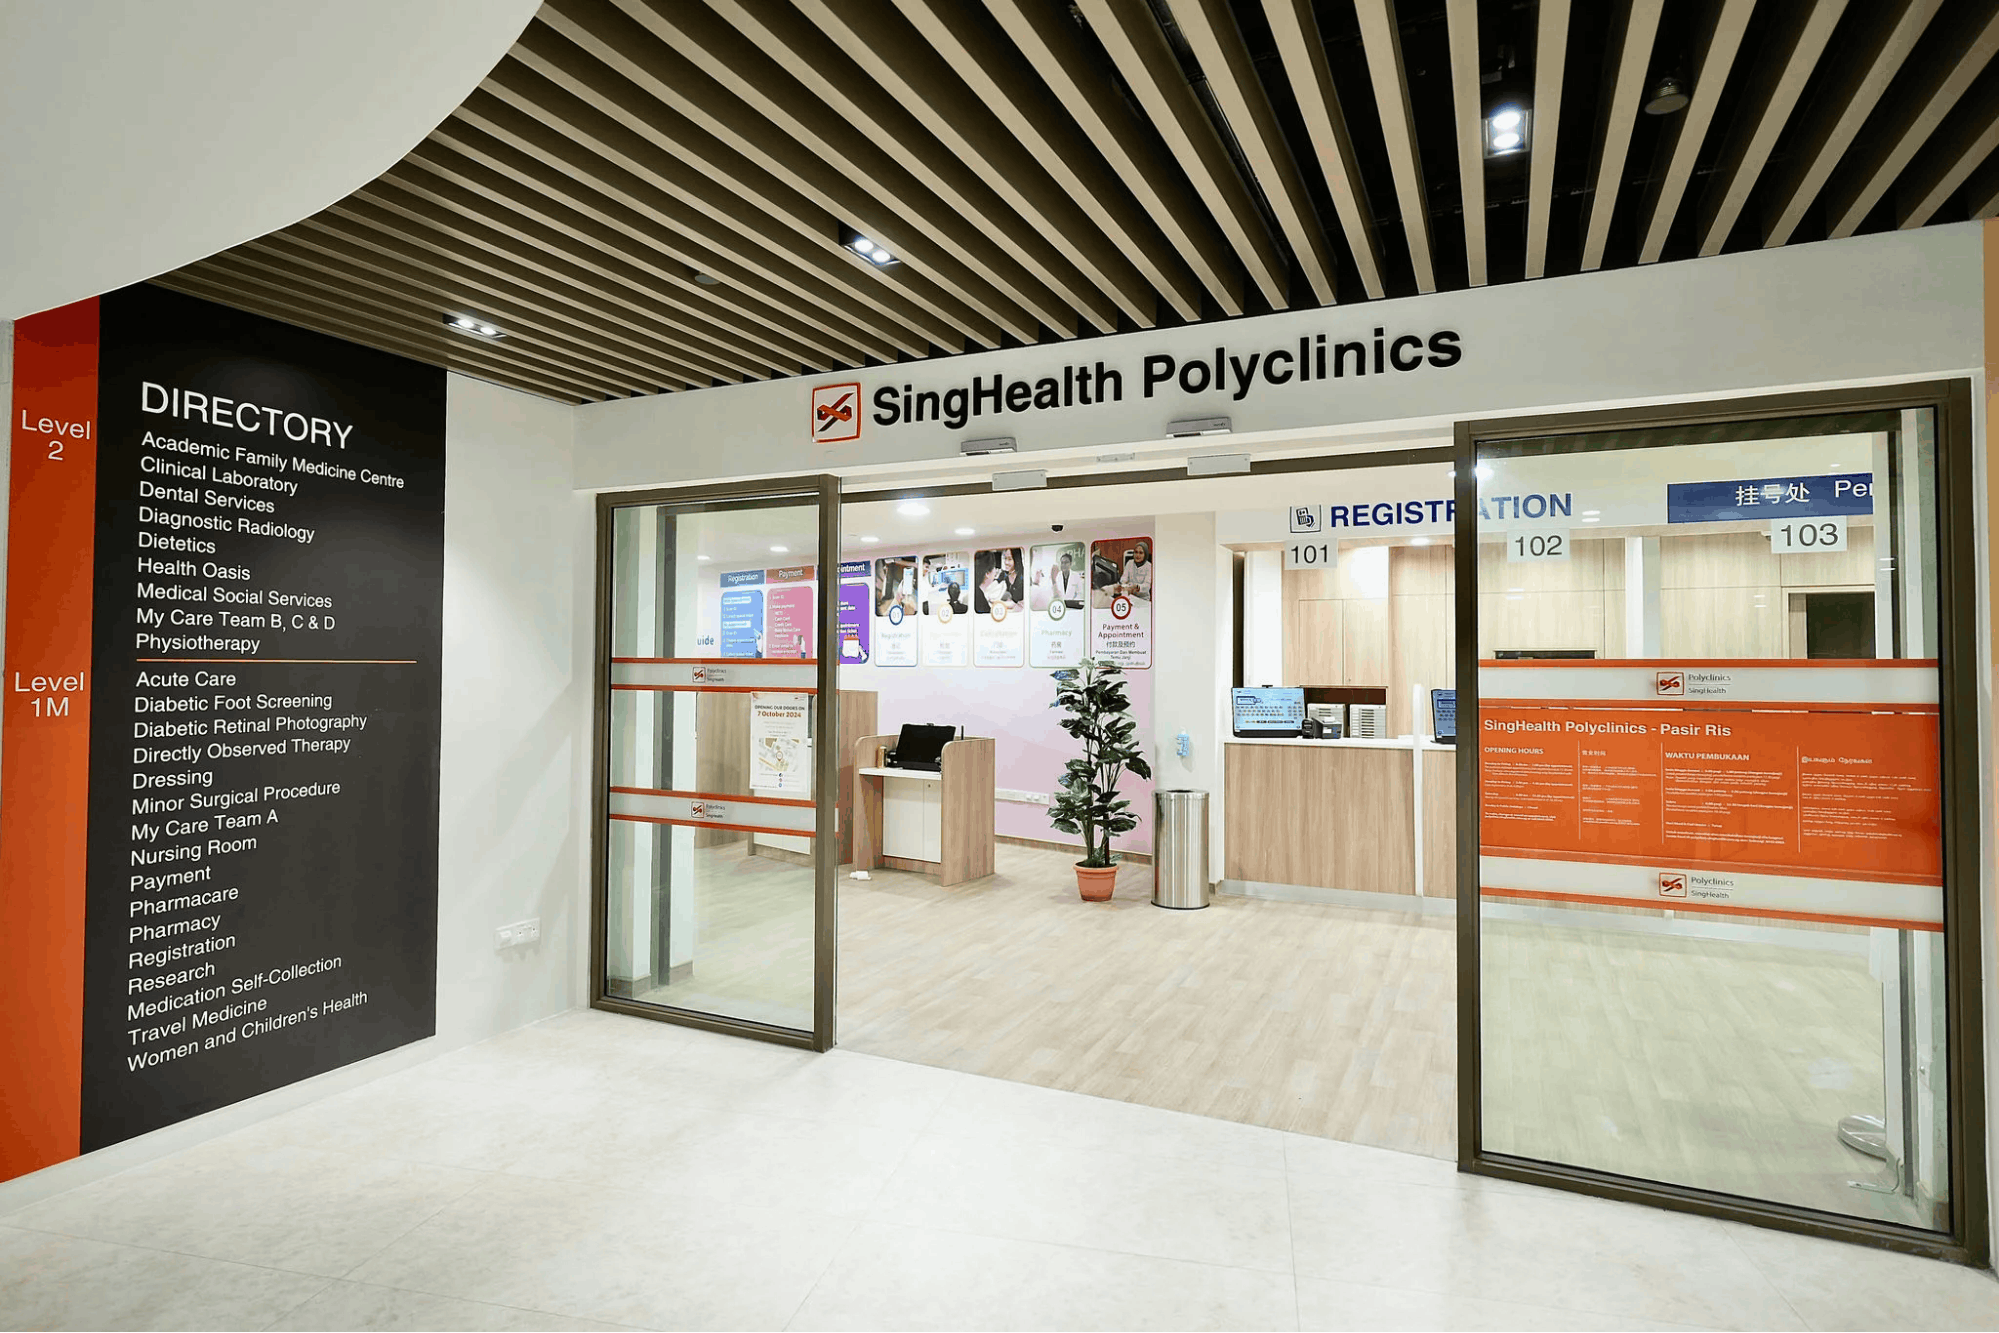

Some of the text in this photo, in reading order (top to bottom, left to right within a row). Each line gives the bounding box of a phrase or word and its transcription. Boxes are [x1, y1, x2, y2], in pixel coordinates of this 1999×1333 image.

[872, 328, 1463, 430] SingHealth Polyclinics
[21, 410, 92, 440] Level
[140, 380, 354, 450] DIRECTORY
[48, 440, 64, 461] 2
[140, 430, 405, 489] Academic Family Medicine Centre
[140, 455, 299, 497] Clinical Laboratory
[139, 480, 275, 514] Dental Services
[1736, 482, 1810, 506] 挂号处
[1331, 493, 1572, 527] REGISTATION
[138, 505, 315, 544] Diagnostic Radiology
[1780, 523, 1839, 547] 103
[138, 531, 216, 554] Dietetics
[1290, 544, 1330, 564] 101
[1515, 535, 1563, 557] 102
[137, 556, 251, 581] Health Oasis
[728, 573, 758, 583] Registration
[778, 569, 804, 579] Payment
[137, 582, 333, 609] Medical Social Services
[1115, 602, 1127, 612] 05
[136, 607, 336, 633] My Care Team B, C & D
[1052, 605, 1062, 614] 04
[1097, 631, 1145, 640] Appointment
[1102, 623, 1133, 631] Payment
[135, 632, 261, 655] Physiotherapy
[14, 672, 85, 692] Level
[135, 670, 237, 688] Acute Care
[1688, 673, 1732, 683] Polyclinics
[1688, 686, 1727, 695] SingHealth
[31, 697, 69, 717] 1M
[134, 693, 333, 713] Diabetic Foot Screening
[762, 710, 785, 718] October
[133, 713, 368, 739] Diabetic Retinal Photography
[1484, 719, 1562, 734] SingHealth
[1565, 721, 1647, 738] Polyclinics
[1660, 723, 1701, 737] Pasir
[1705, 724, 1732, 737] Ris
[133, 738, 351, 764] Directly Observed Therapy
[1484, 746, 1544, 755] OPENING HOURS
[1665, 751, 1750, 761] WAKTU PEMBUKAAN
[132, 769, 213, 790] Dressing
[132, 781, 341, 816] Minor Surgical Procedure
[131, 808, 279, 843] My Care Team A
[130, 837, 257, 867] Nursing Room
[130, 865, 212, 893] Payment
[1691, 876, 1735, 887] Polyclinics
[130, 887, 239, 919] Pharmacare
[1690, 889, 1730, 899] SingHealth
[129, 914, 221, 944] Pharmacy
[128, 935, 236, 970] Registration
[127, 956, 342, 1022] Medication Self-Collection
[128, 961, 215, 996] Research
[127, 998, 269, 1046] Travel Medicine
[127, 991, 368, 1072] Women and Children's Health
